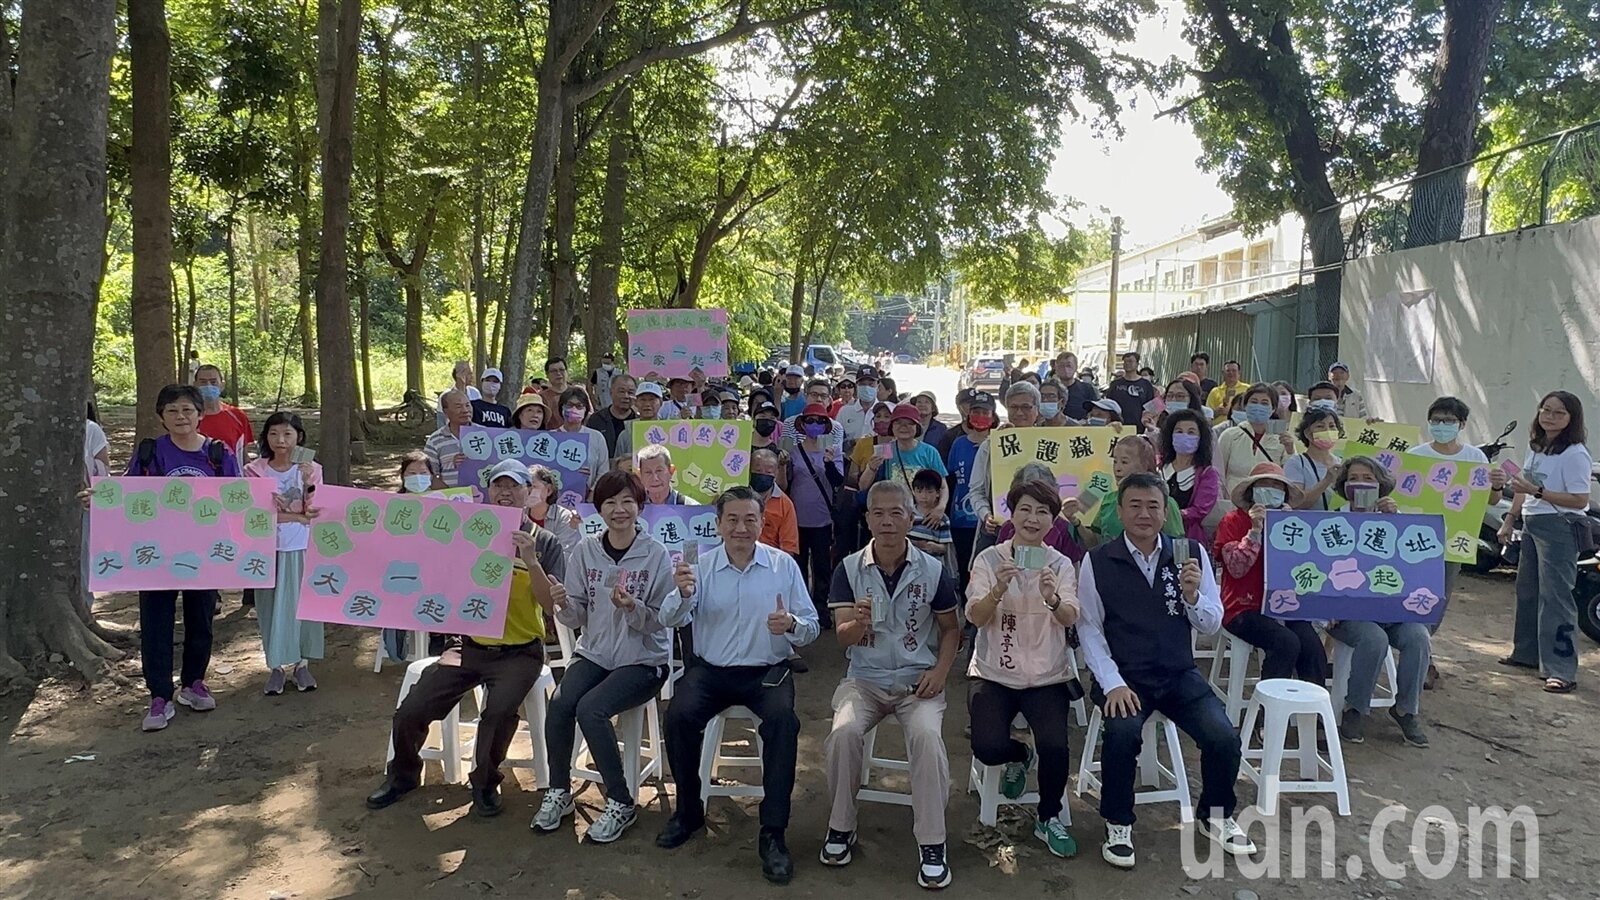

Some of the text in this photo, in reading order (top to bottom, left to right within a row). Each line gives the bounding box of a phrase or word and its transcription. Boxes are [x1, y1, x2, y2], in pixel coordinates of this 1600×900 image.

[632, 346, 723, 367] 大家一起來
[481, 410, 505, 426] MOM
[469, 436, 581, 463] 守護遺址
[99, 484, 272, 531] 守護虎山林場
[320, 505, 504, 584] 守護虎山林場
[585, 521, 717, 545] 守遺址
[1282, 522, 1437, 555] 守護遺址
[98, 542, 267, 576] 大家一起來
[313, 564, 488, 623] 大家一起來
[1553, 621, 1575, 658] 5
